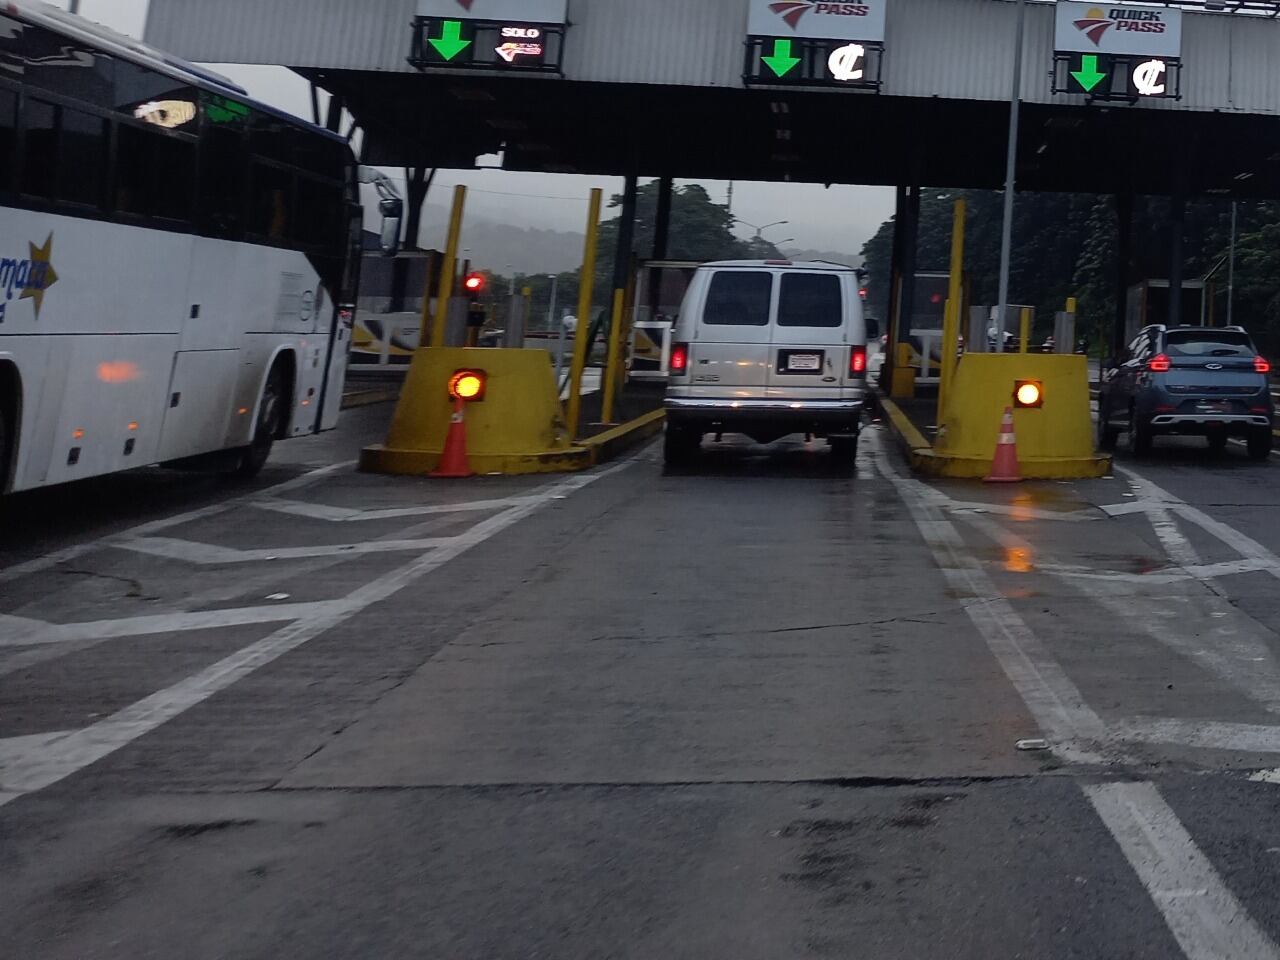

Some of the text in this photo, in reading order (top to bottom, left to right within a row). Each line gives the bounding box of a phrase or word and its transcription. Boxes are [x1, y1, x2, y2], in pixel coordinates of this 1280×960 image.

[814, 3, 869, 16] PASS
[1108, 9, 1162, 21] QUICK
[1115, 20, 1166, 33] PASS
[501, 27, 540, 39] SOLO
